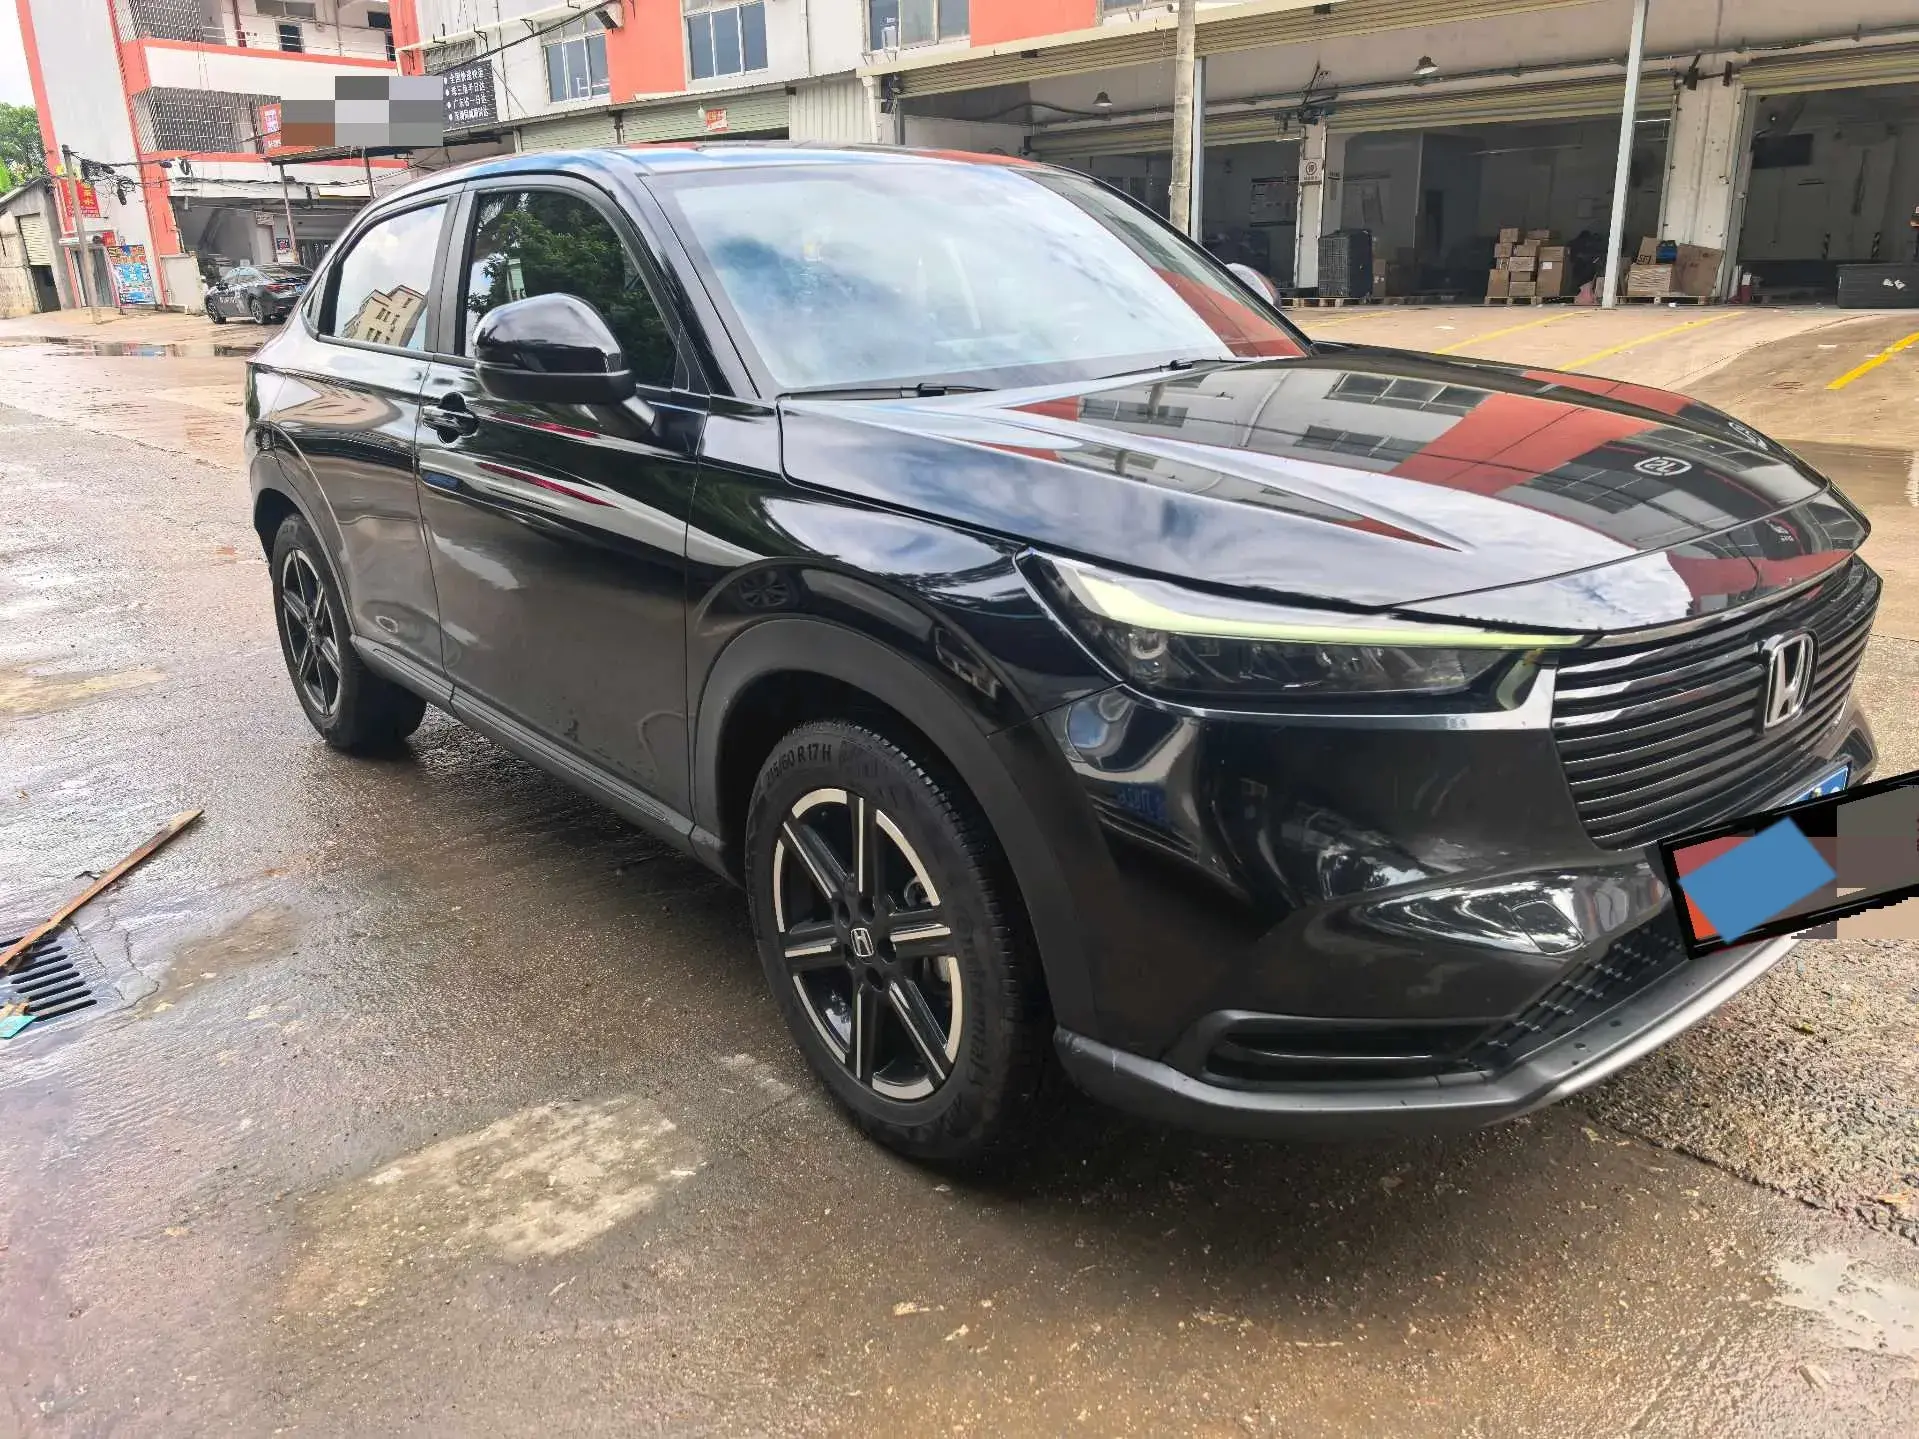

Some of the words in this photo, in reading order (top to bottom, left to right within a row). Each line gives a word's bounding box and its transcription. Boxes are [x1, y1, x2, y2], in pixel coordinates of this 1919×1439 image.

[797, 744, 806, 762] R
[807, 743, 819, 761] 17
[822, 744, 832, 762] H
